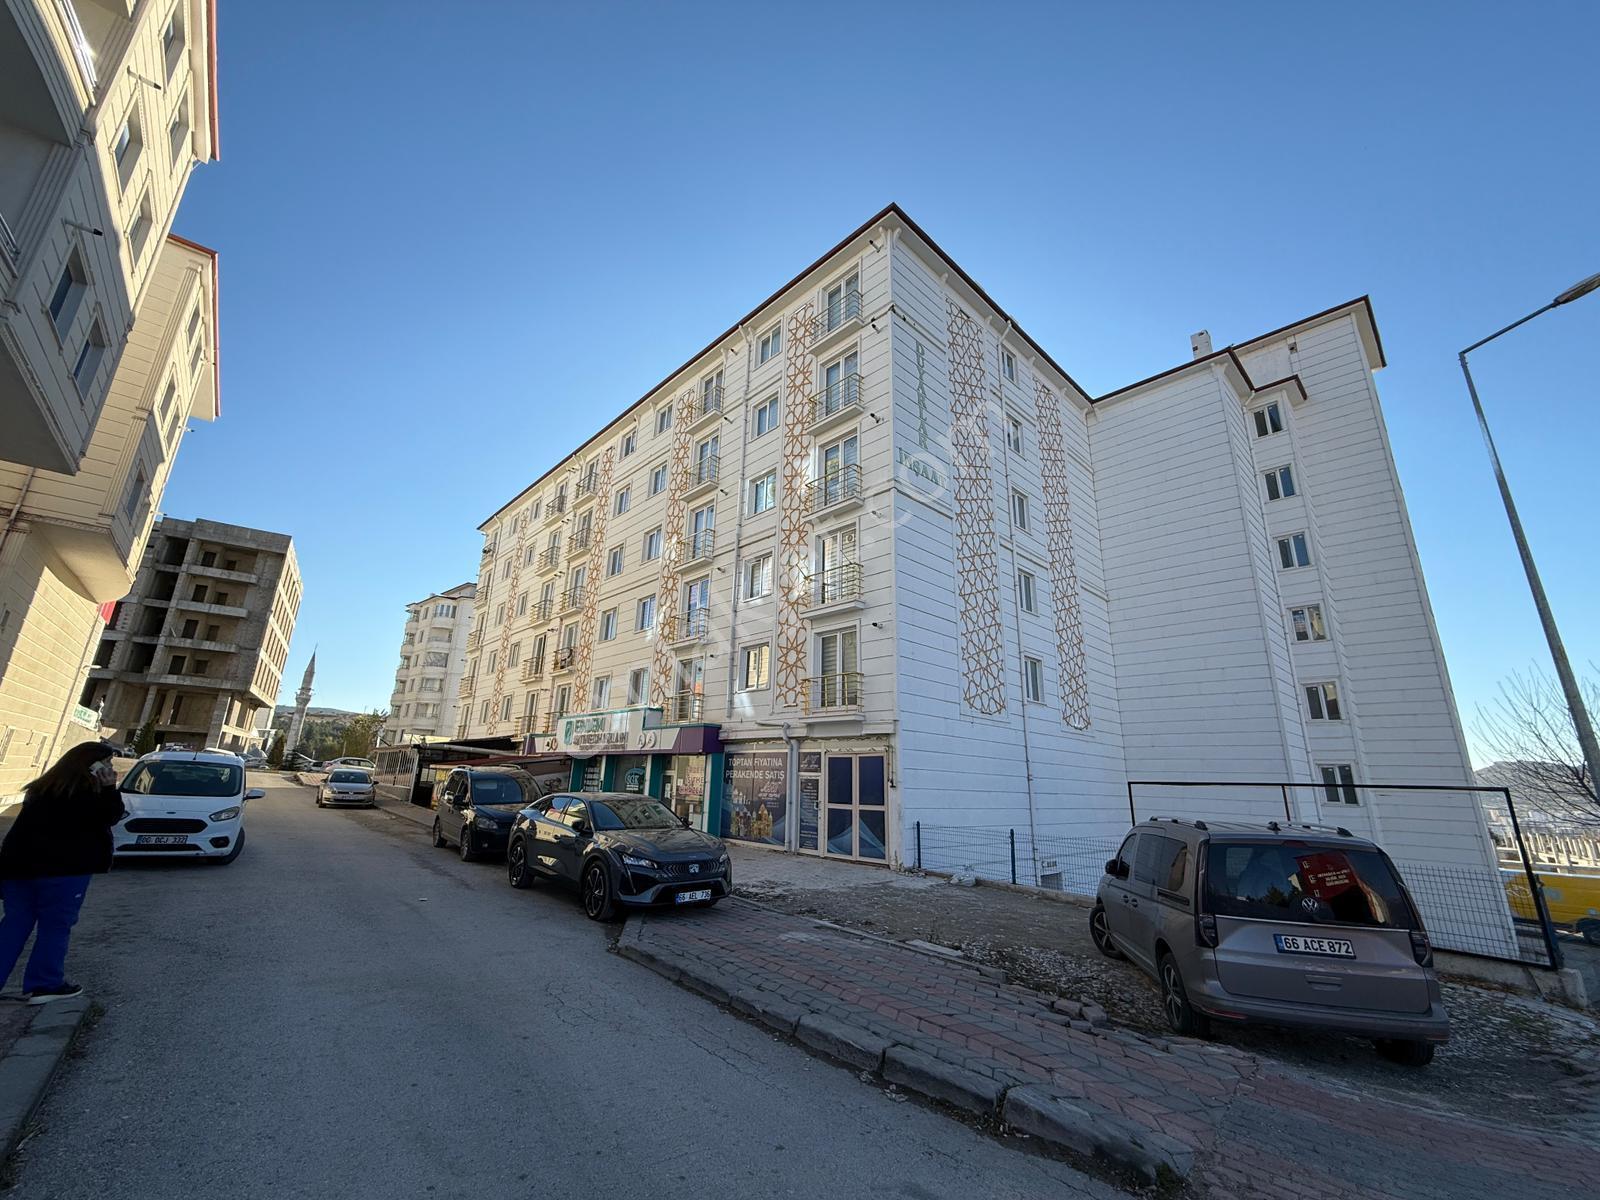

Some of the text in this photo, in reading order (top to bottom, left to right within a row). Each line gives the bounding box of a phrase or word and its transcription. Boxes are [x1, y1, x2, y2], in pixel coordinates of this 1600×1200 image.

[728, 758, 753, 767] TOPTAN
[725, 770, 785, 781] PERAKENDE SATIŞ
[1283, 937, 1352, 955] 66 ACE 872
